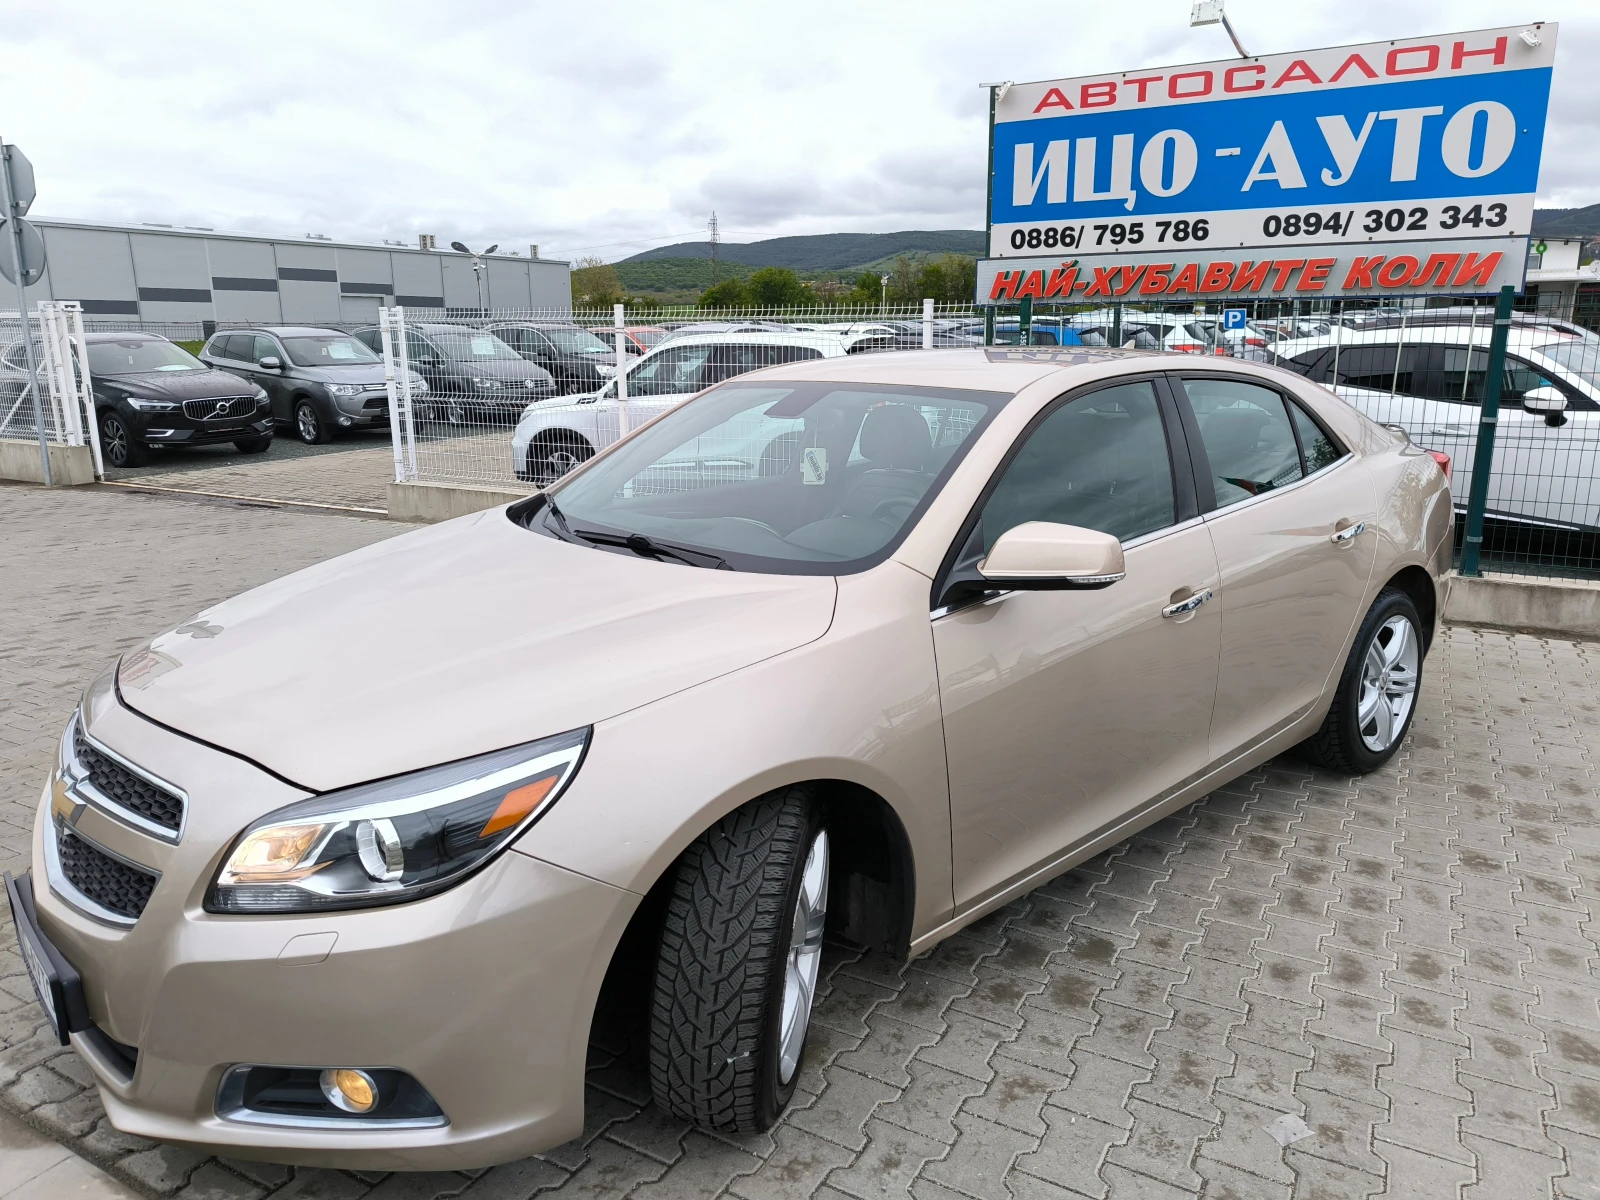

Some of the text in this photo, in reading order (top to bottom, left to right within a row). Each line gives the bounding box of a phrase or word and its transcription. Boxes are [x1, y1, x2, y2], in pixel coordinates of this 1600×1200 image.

[1033, 36, 1508, 114] АВТОСАЛОН
[1010, 203, 1508, 250] 0886/ 795 786 0894/ 302 343
[988, 251, 1504, 300] НАЙ-ХУБАВИТЕ КОЛИ
[1228, 311, 1242, 328] P
